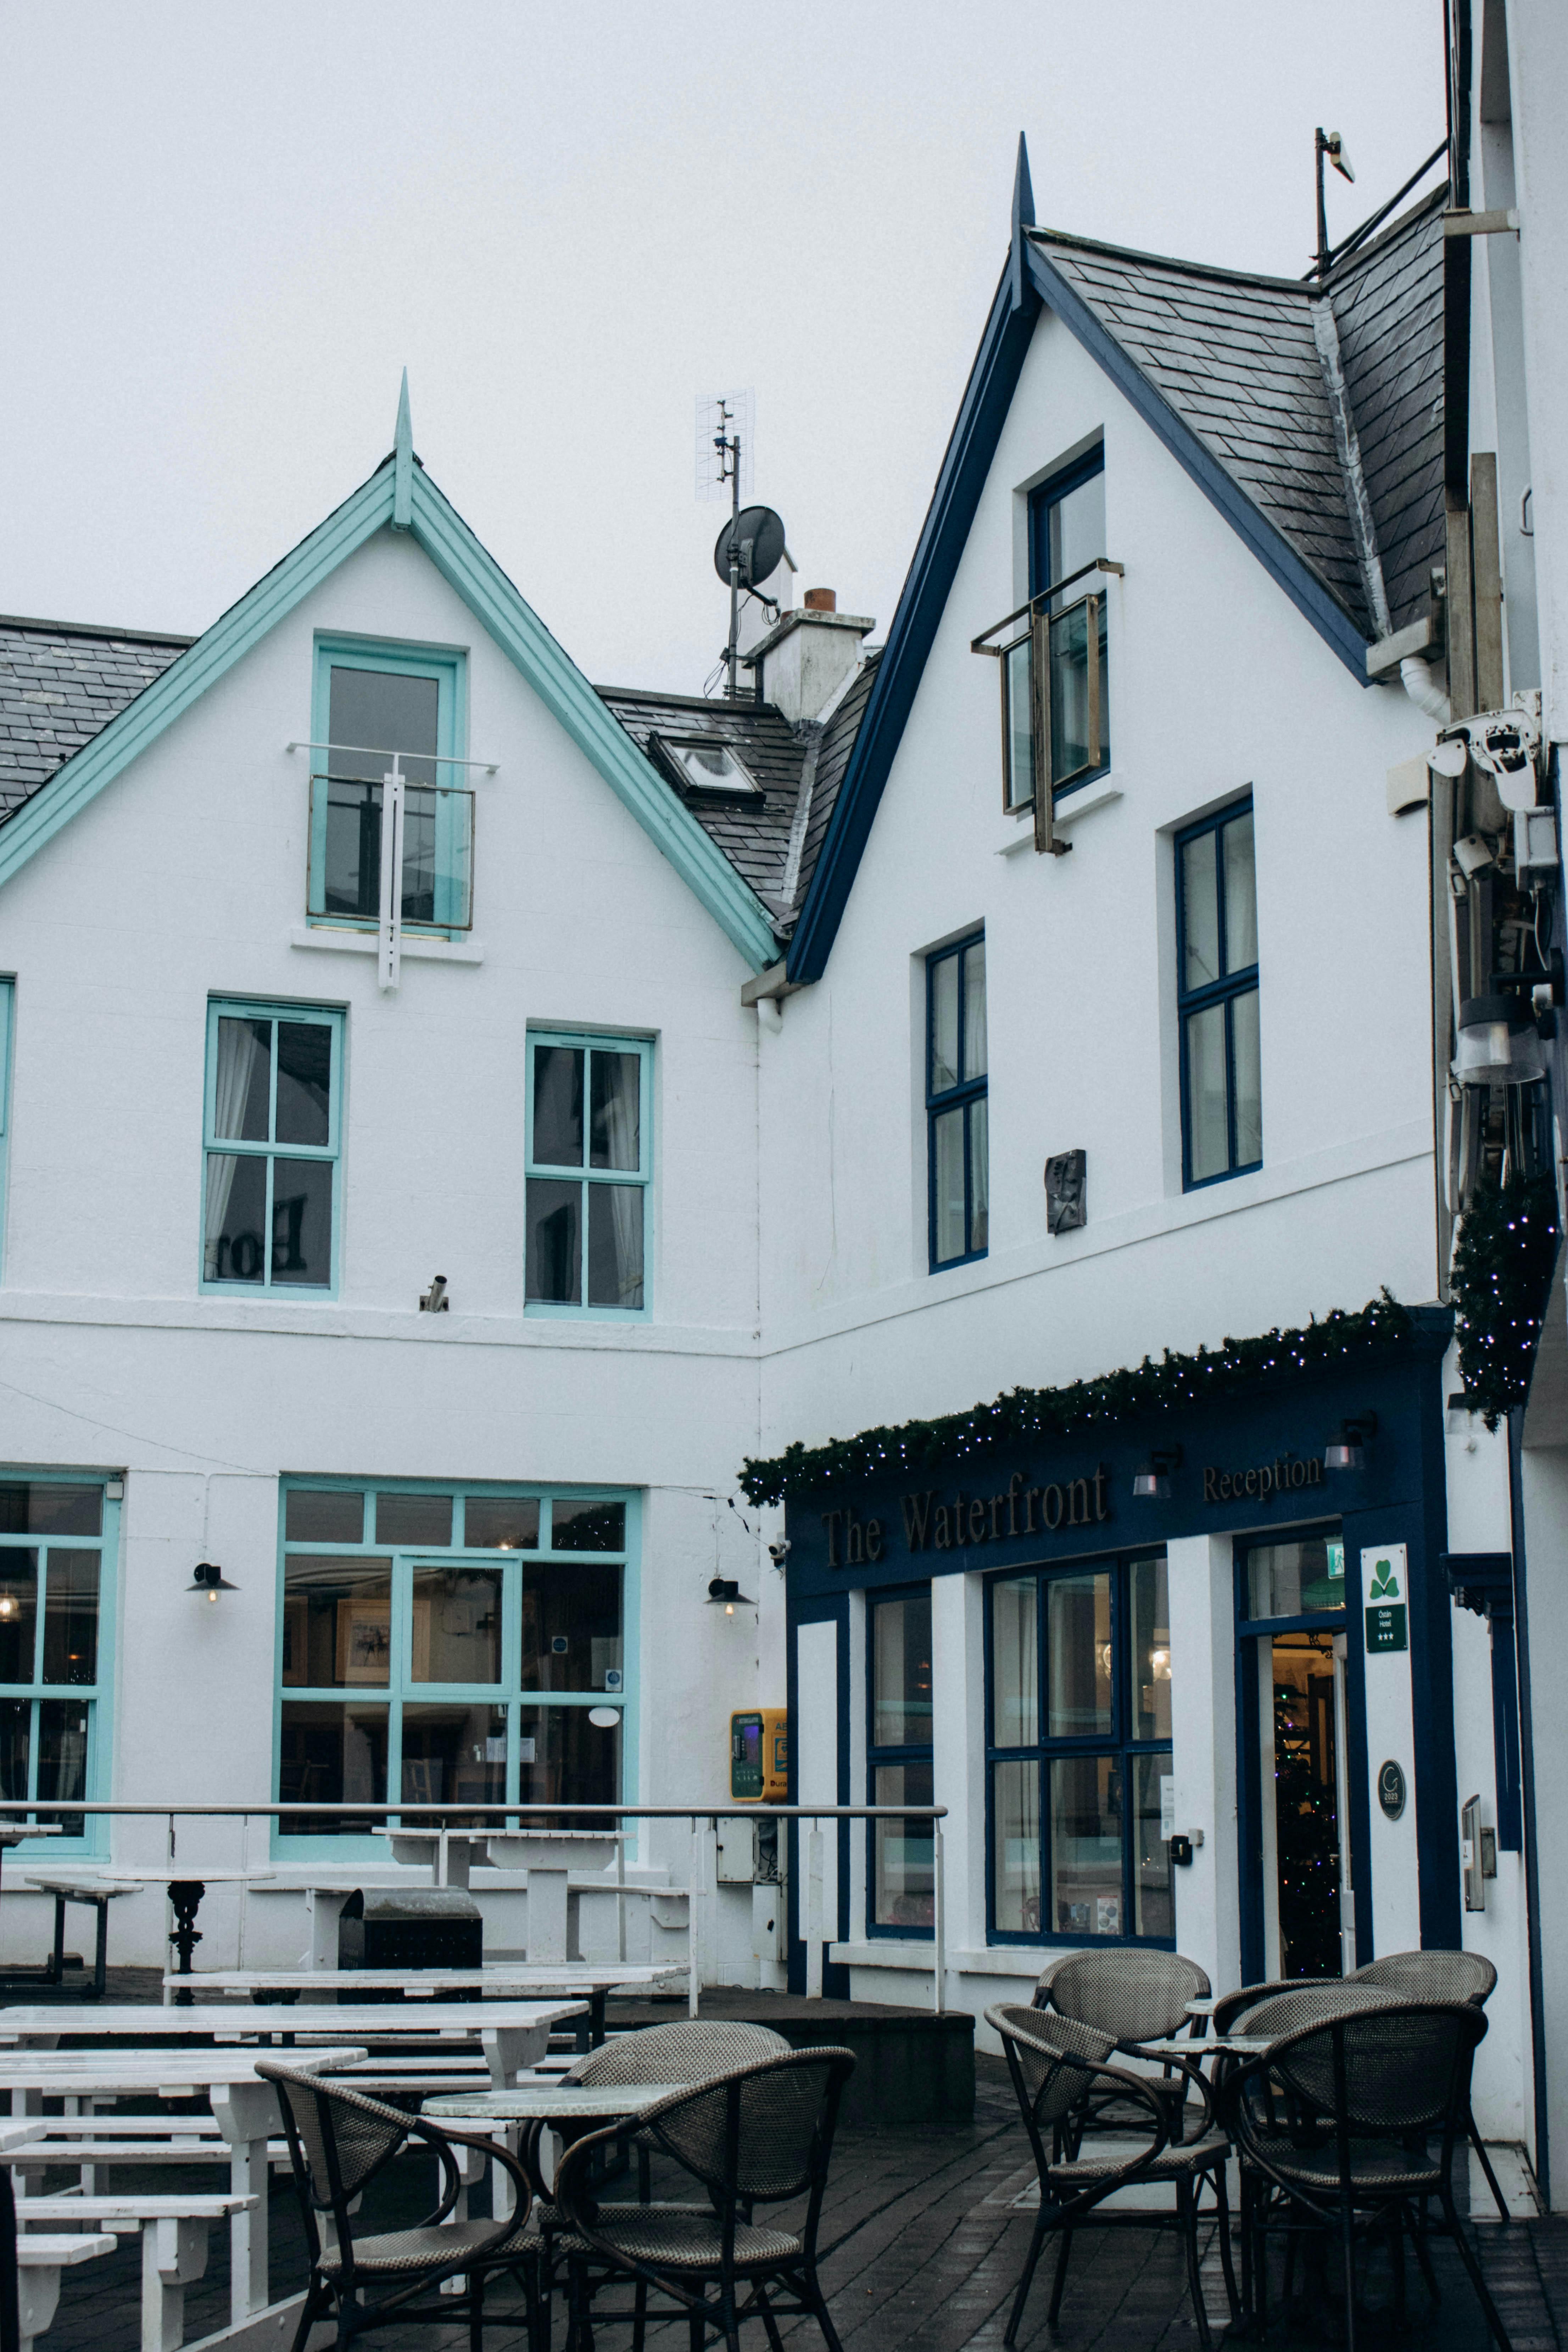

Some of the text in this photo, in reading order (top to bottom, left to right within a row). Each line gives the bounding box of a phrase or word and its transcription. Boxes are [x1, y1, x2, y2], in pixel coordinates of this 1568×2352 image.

[1203, 1452, 1321, 1501] Reception
[821, 1466, 1107, 1567] The Waterfront
[1379, 1619, 1392, 1627] Hotel
